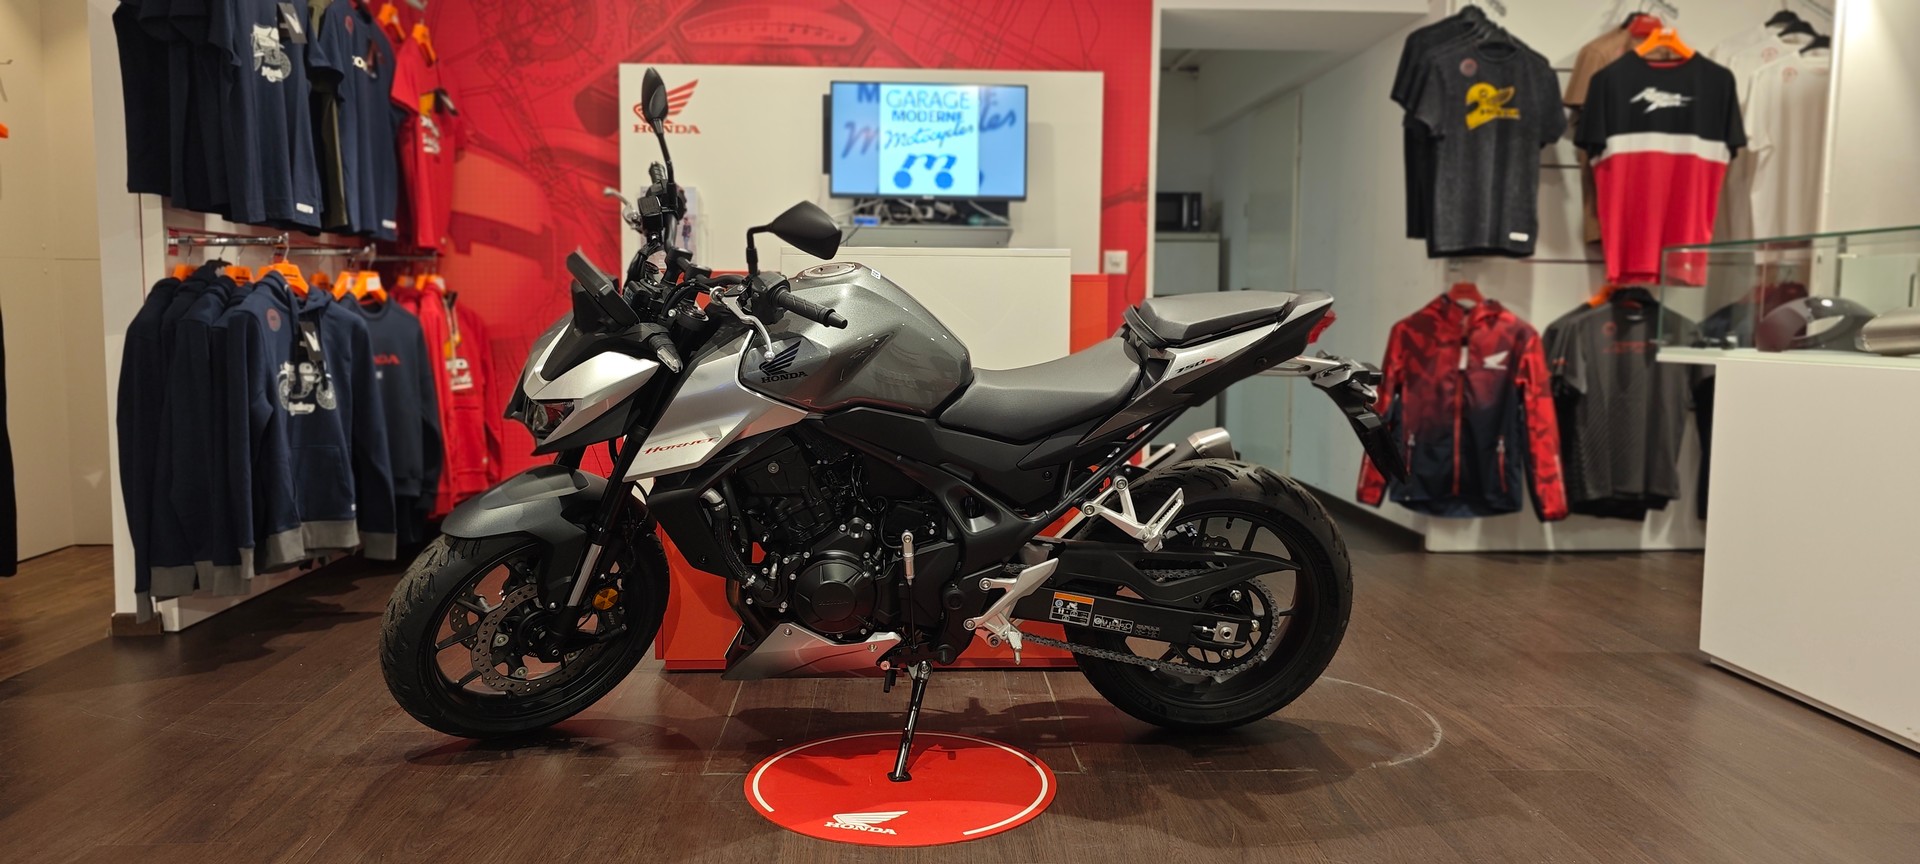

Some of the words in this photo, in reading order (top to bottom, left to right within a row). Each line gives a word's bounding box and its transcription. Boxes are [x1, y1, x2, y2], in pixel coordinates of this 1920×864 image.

[886, 89, 971, 109] GARAGE
[891, 110, 963, 123] MODERNE
[760, 371, 809, 384] HONDA
[824, 821, 897, 835] HONDA
